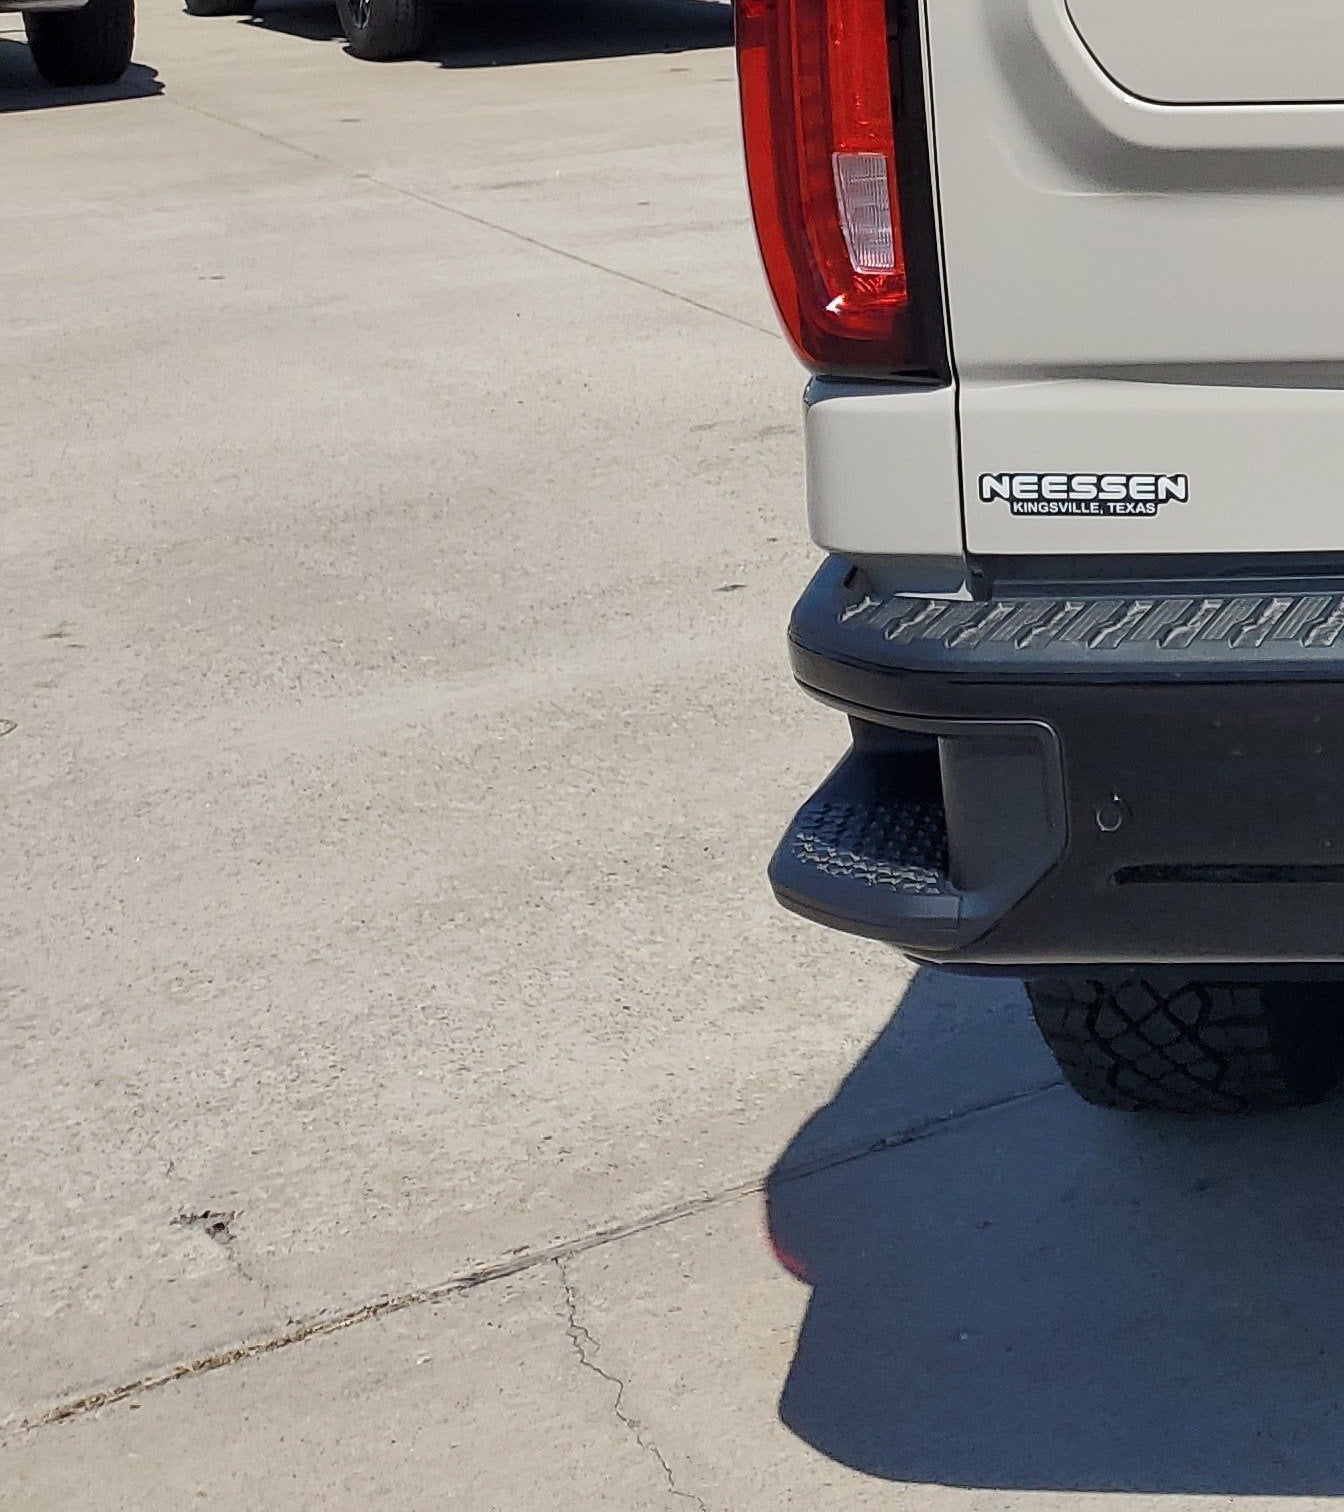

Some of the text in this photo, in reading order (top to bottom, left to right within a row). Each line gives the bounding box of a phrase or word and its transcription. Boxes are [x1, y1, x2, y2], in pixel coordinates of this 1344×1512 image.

[982, 475, 1186, 500] NEESSEN
[1012, 501, 1156, 515] KINGSVILLE, TEXAS
